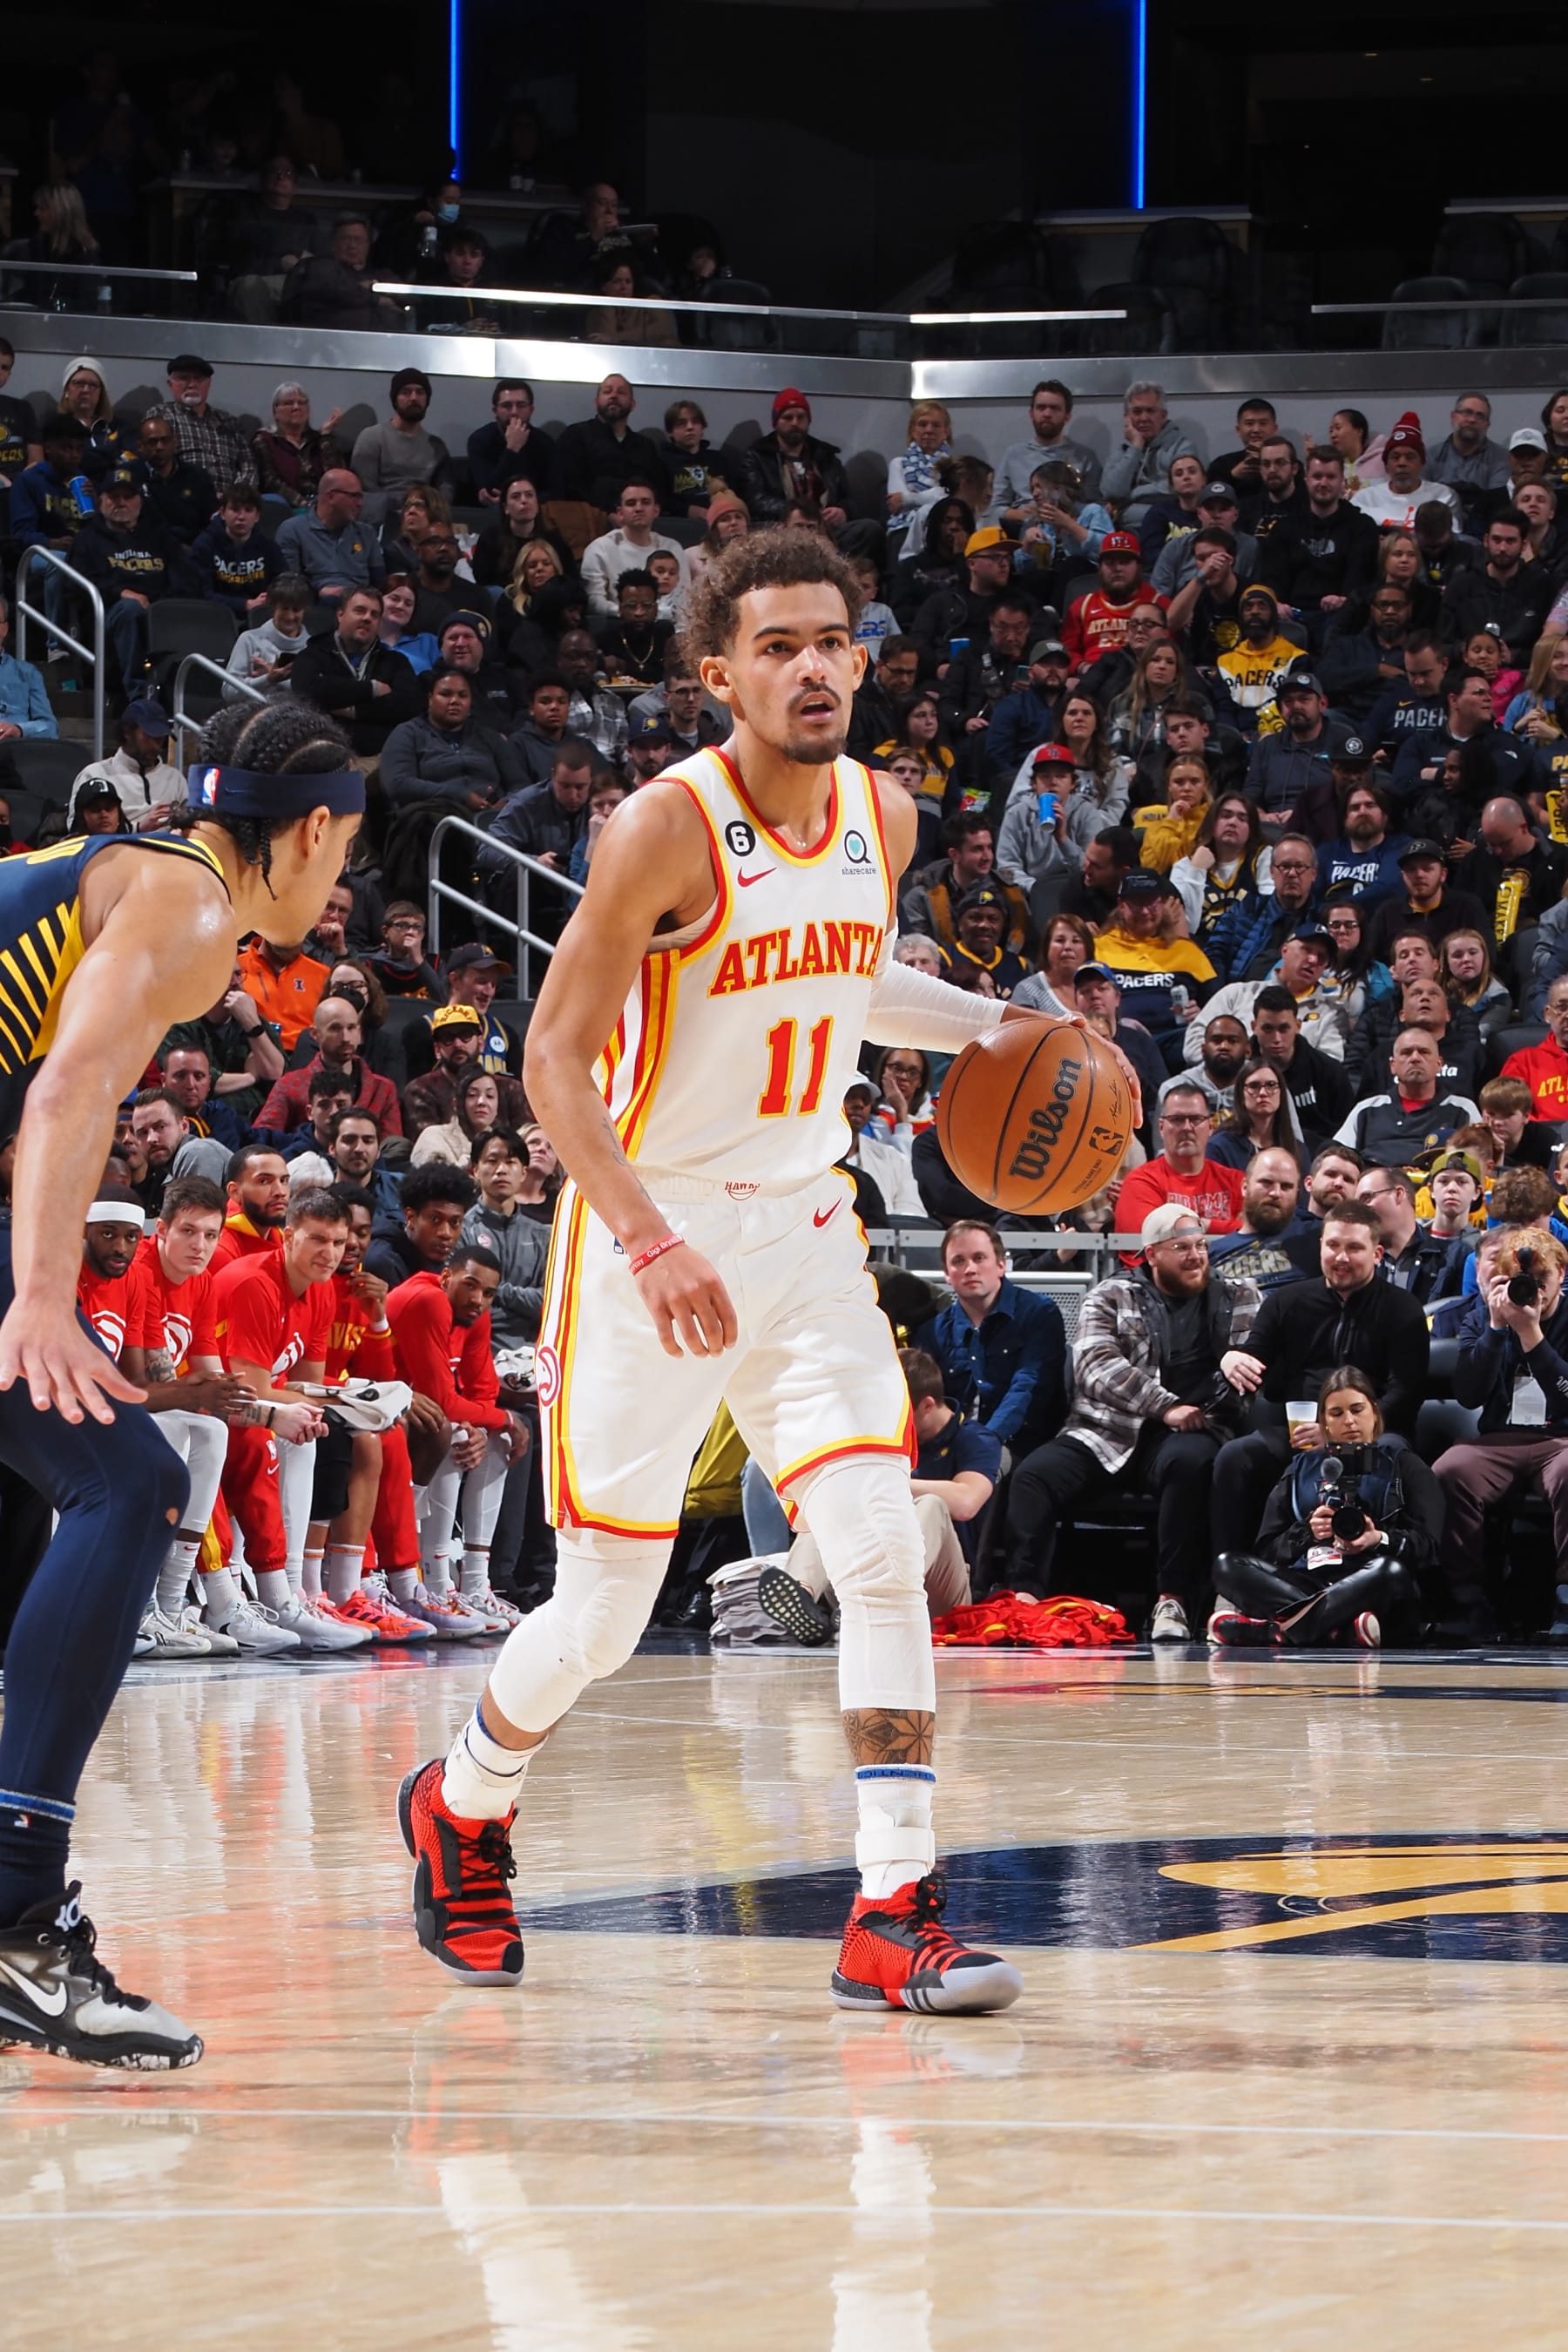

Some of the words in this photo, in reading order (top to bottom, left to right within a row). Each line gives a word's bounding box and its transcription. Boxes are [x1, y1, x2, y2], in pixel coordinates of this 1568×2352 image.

[107, 557, 166, 571] PACERS
[213, 555, 266, 576] PACERS
[1086, 618, 1130, 635] ATLAN
[1225, 668, 1286, 691] PACERS
[1394, 707, 1448, 728] PACE
[730, 825, 751, 853] 6
[841, 867, 876, 875] sharecare
[1331, 861, 1380, 885] PACER
[1115, 972, 1175, 989] PACERS
[756, 1014, 835, 1119] 11
[1010, 1058, 1083, 1181] Wilson
[646, 1245, 661, 1258] Gigi
[1215, 1249, 1293, 1279] ACERS
